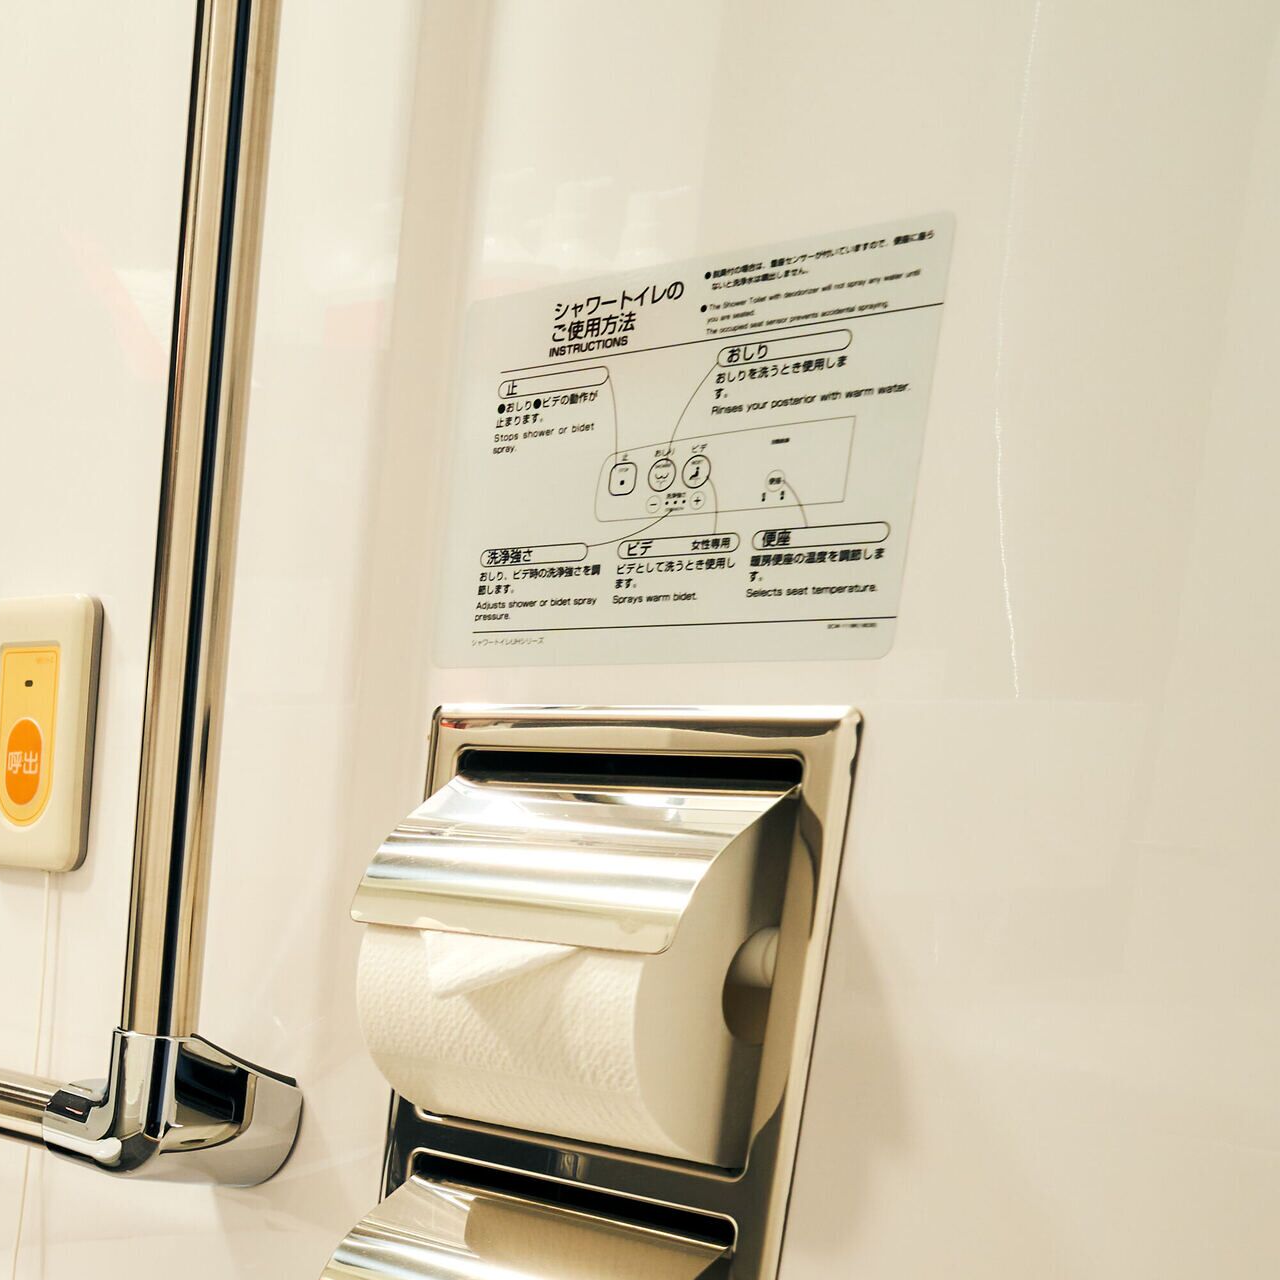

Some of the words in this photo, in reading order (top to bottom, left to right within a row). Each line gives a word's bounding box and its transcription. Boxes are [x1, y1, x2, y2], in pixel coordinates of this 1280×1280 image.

[554, 281, 685, 321] シャワートイレの
[709, 302, 721, 311] The
[722, 298, 747, 309] Shower
[847, 279, 866, 289] spray
[868, 276, 881, 286] any
[883, 272, 903, 282] water
[551, 310, 637, 342] ご使用方法
[706, 315, 719, 324] you
[720, 314, 731, 322] are
[706, 327, 718, 336] The
[719, 322, 748, 335] occupied
[750, 320, 764, 329] seat
[766, 317, 787, 327] sensor
[789, 311, 819, 323] prevents
[821, 305, 856, 318] accidental
[548, 335, 629, 358] INSTRUCTIONS
[726, 342, 769, 364] おしり
[715, 355, 848, 385] おしりを洗うとき使用しま
[506, 379, 518, 396] 止
[711, 402, 744, 416] Rinses
[746, 399, 769, 413] your
[770, 393, 817, 409] posterior
[820, 390, 841, 402] with
[844, 387, 875, 399] warm
[495, 413, 544, 429] 止まります。
[494, 432, 519, 443] Stops
[523, 427, 555, 439] shower
[558, 426, 567, 435] or
[571, 423, 595, 433] bidet
[626, 540, 654, 556] ビデ
[691, 537, 731, 551] 女性専用
[762, 529, 792, 548] 便座
[486, 548, 533, 565] 洗浄強さ
[616, 557, 736, 575] ビデとして洗うとき使用し
[614, 578, 637, 589] ます。
[746, 588, 782, 598] Selects
[785, 587, 809, 596] seat
[476, 601, 506, 611] Adjusts
[508, 599, 537, 608] shower
[539, 599, 548, 607] or
[550, 598, 571, 607] bidet
[573, 597, 597, 607] spray
[612, 594, 643, 605] Sprays
[645, 593, 671, 602] warm
[7, 751, 39, 776] 呼出
